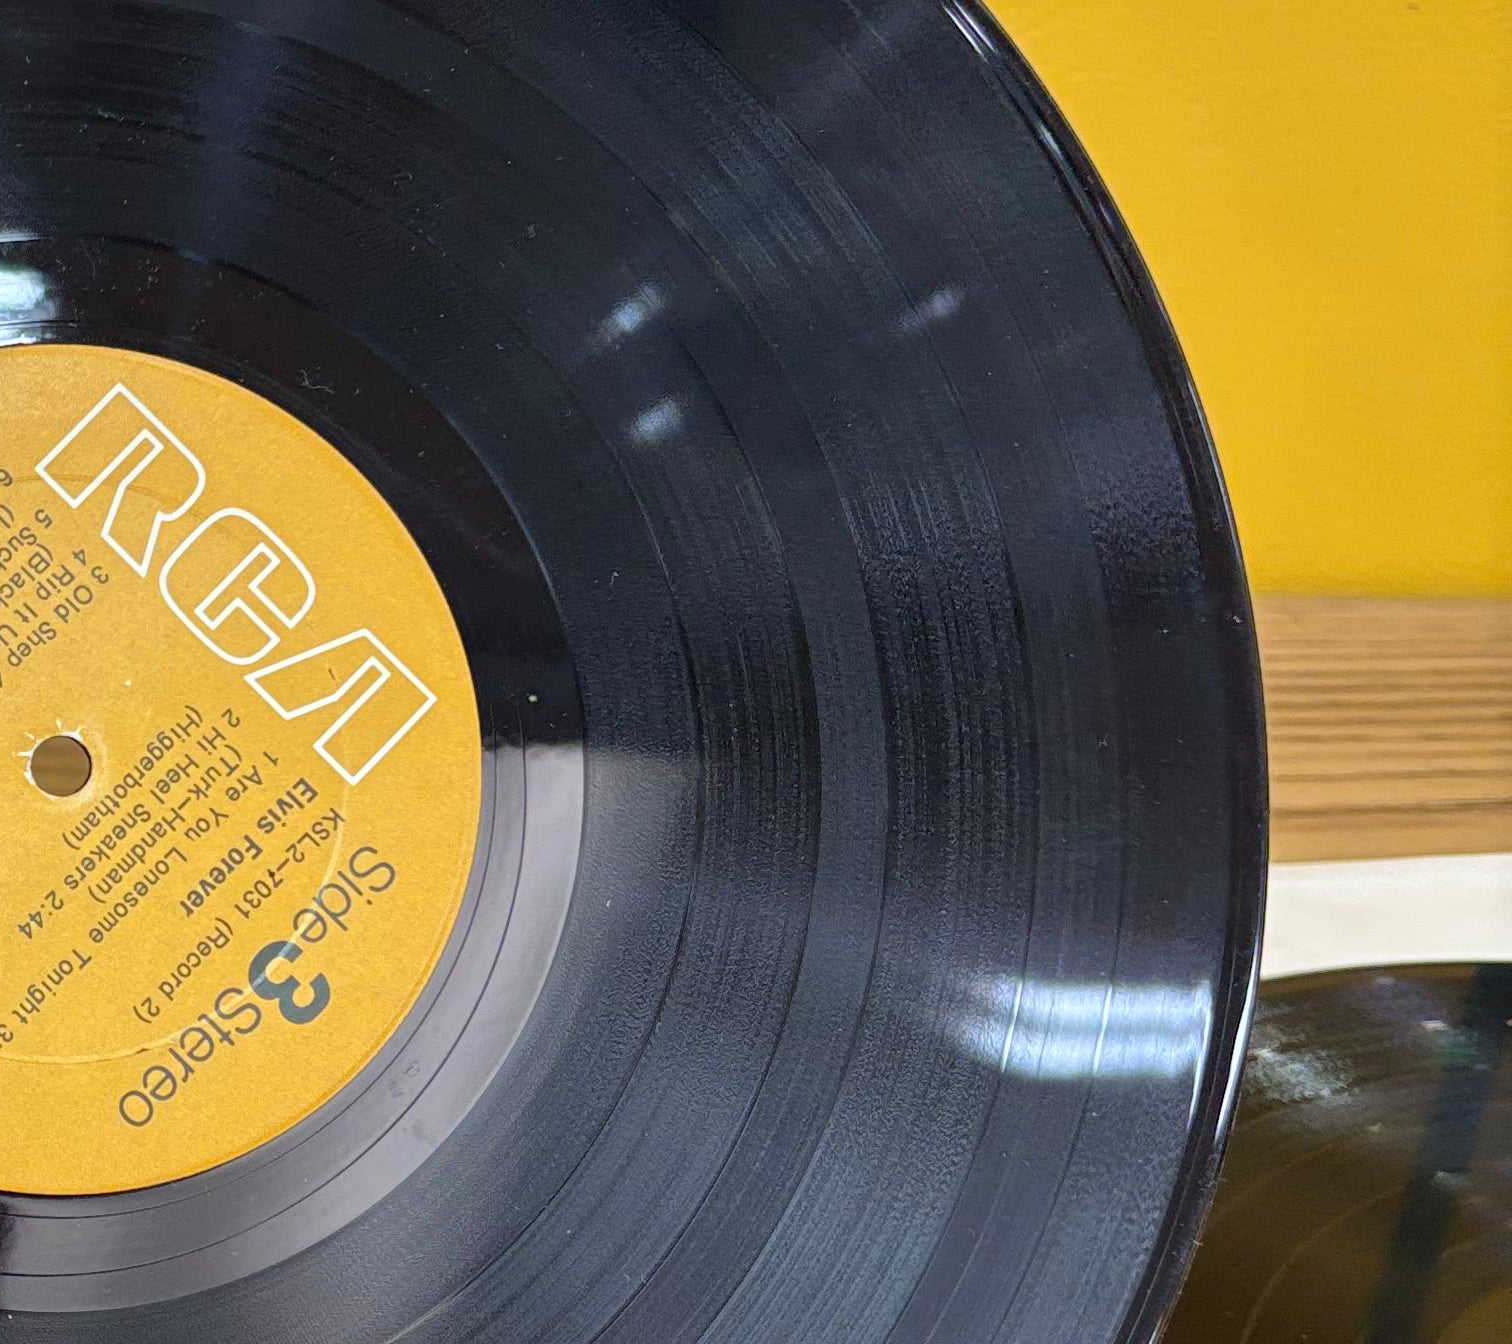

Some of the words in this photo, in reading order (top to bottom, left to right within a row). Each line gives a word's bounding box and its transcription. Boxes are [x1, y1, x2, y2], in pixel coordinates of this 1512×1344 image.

[35, 509, 52, 528] 5
[72, 549, 86, 566] 4
[91, 566, 109, 584] 3
[35, 382, 437, 786] RCA
[36, 565, 75, 600] Rip
[53, 585, 93, 623] Old
[14, 603, 38, 623] It
[8, 622, 56, 667] Shep
[197, 727, 226, 755] Hi
[221, 708, 240, 728] 2
[62, 705, 202, 850] (Higgerbotham)
[150, 754, 199, 804] Heel
[226, 765, 262, 801] Are
[263, 751, 278, 766] 1
[88, 744, 242, 903] (Turk-Handman)
[184, 808, 229, 840] You
[257, 778, 318, 834] Elvis
[64, 804, 151, 890] Sneakers
[234, 808, 345, 919] KSL2-7031
[89, 847, 187, 943] Lonesome
[180, 835, 263, 917] Forever
[293, 847, 395, 943] Side
[18, 890, 64, 939] 2:44
[158, 918, 233, 1001] (Record
[248, 941, 330, 1024] 3
[12, 949, 92, 1024] Tonight
[133, 997, 160, 1023] 2)
[119, 988, 261, 1127] Stereo
